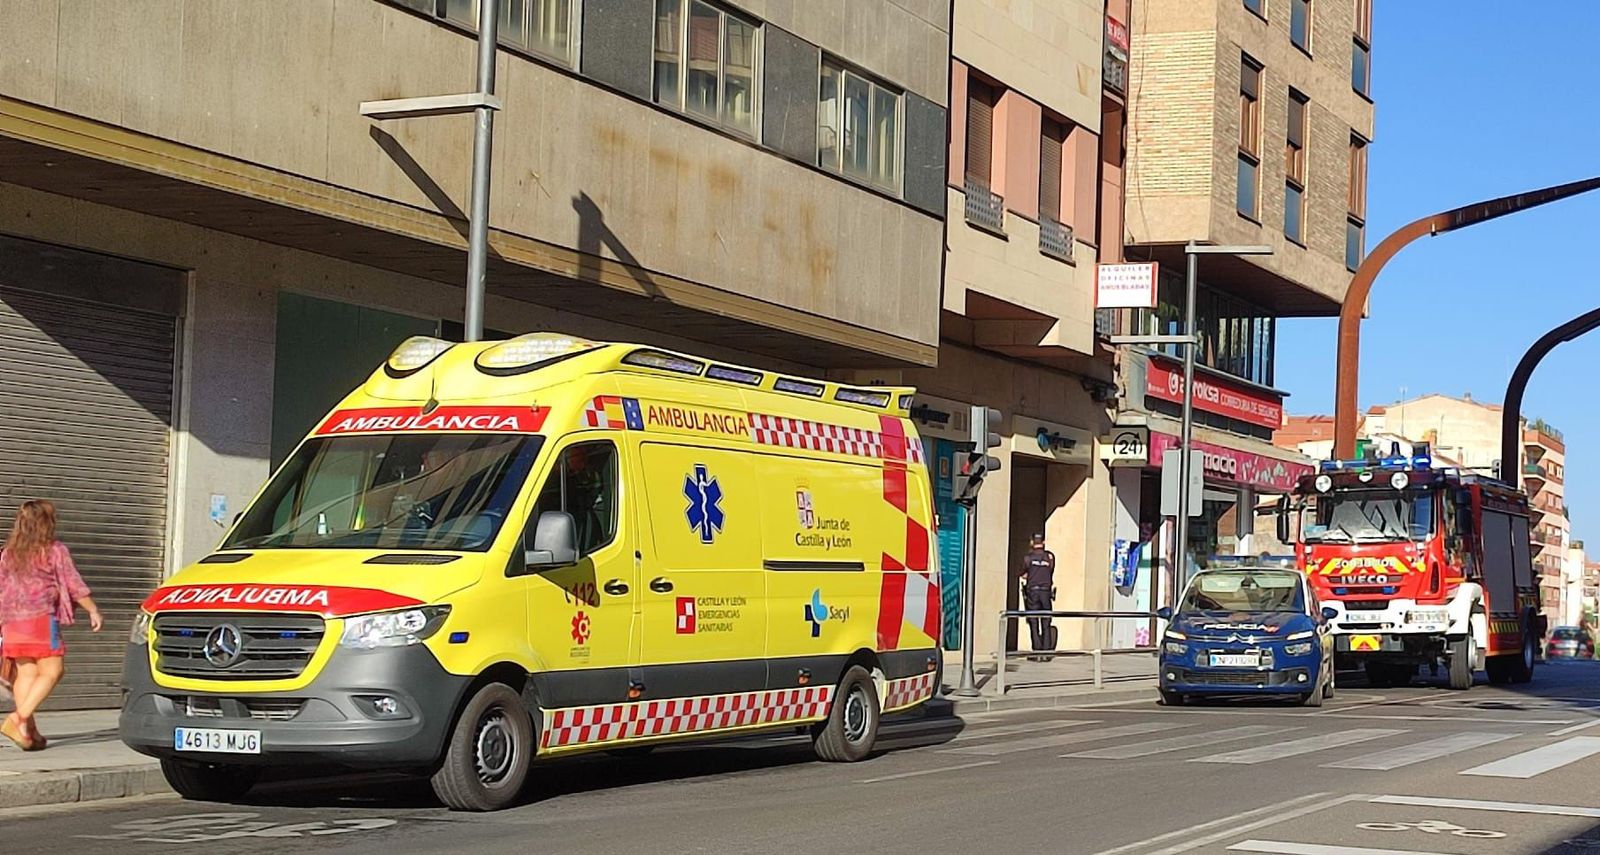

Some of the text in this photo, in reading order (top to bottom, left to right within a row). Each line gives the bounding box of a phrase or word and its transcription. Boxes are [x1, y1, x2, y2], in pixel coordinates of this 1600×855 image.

[1179, 376, 1220, 404] aroksa
[330, 415, 520, 431] AMBULANCIA
[648, 405, 749, 436] AMBULANCIA
[1118, 440, 1138, 455] 24
[816, 517, 850, 531] Junta de
[795, 533, 825, 547] Castilla
[826, 536, 831, 550] y
[1341, 575, 1388, 584] IVECO
[573, 583, 594, 606] 112
[697, 597, 725, 606] CASTILLA
[725, 597, 730, 606] Y
[698, 610, 741, 619] EMERGENCIAS
[829, 606, 850, 622] Sacyl
[698, 623, 733, 632] SANITARIAS
[1203, 623, 1268, 631] POLICIA
[185, 731, 256, 750] 4613 MJG
